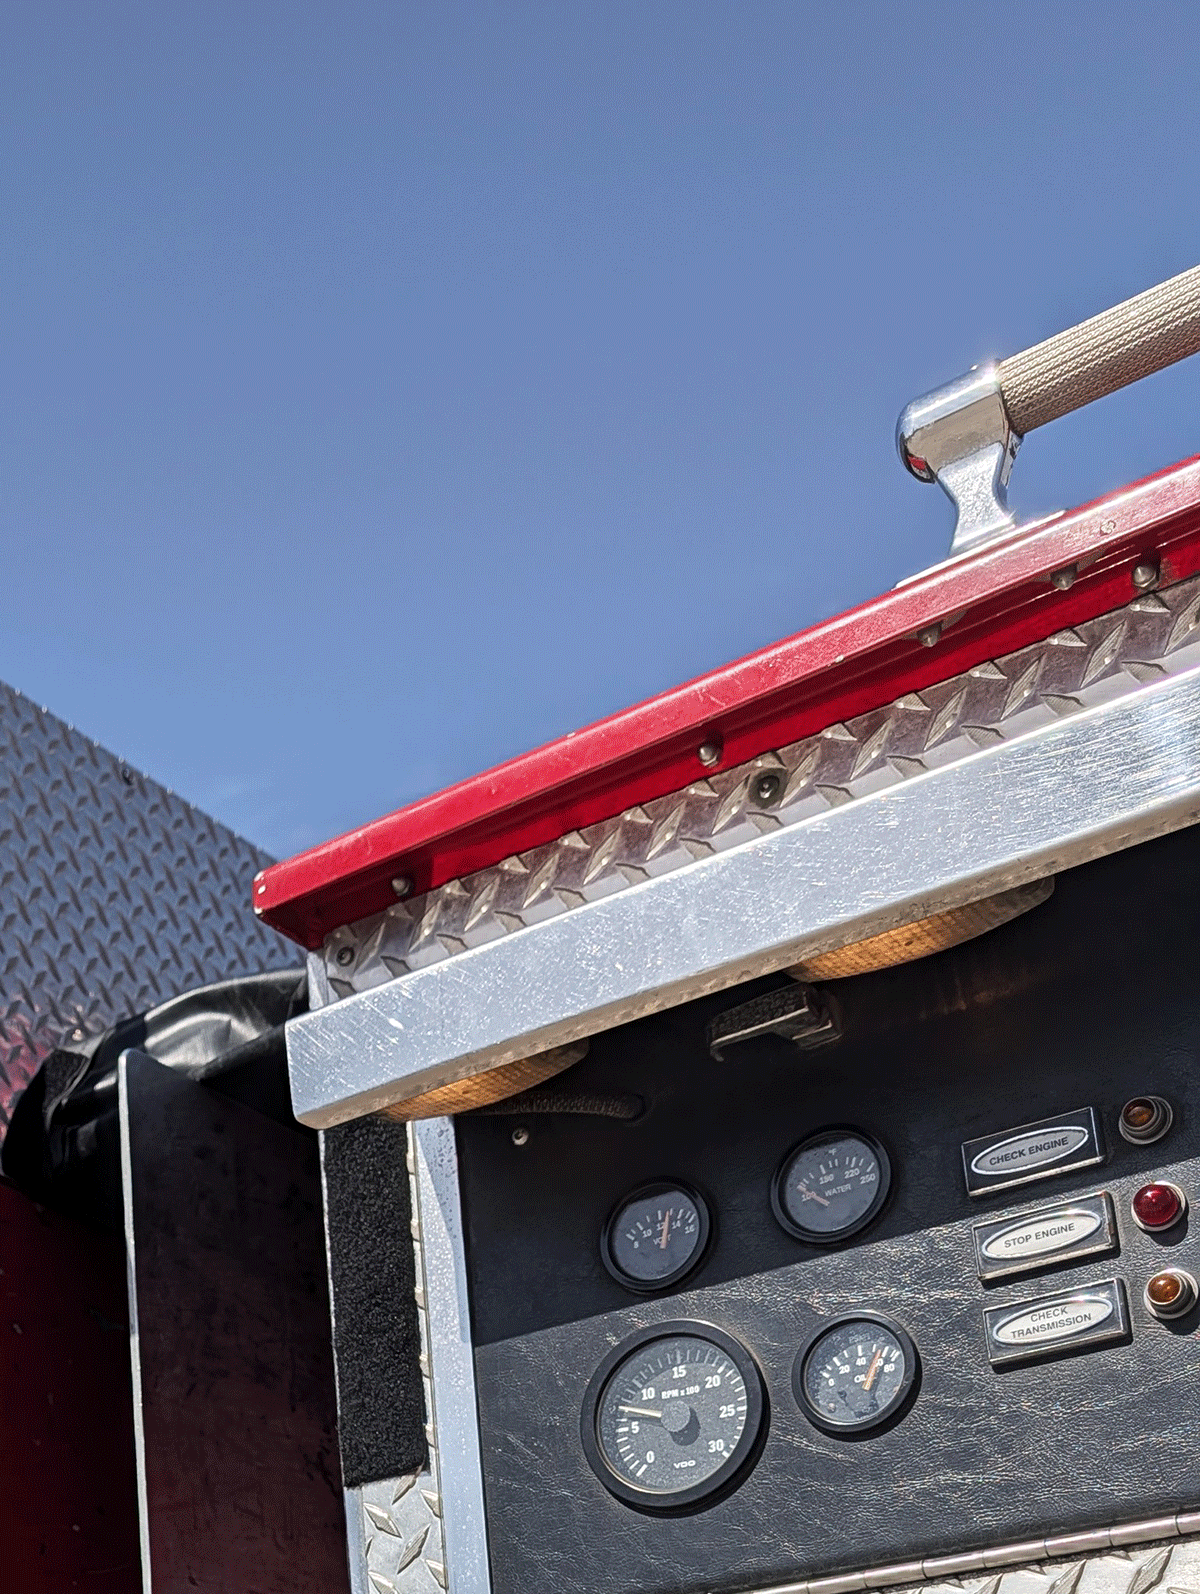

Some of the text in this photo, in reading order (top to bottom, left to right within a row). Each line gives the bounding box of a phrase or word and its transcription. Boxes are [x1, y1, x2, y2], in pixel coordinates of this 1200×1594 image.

[989, 1136, 1069, 1166] CHECK ENGINE
[844, 1168, 860, 1179] 220
[860, 1173, 876, 1185] 250
[825, 1183, 852, 1197] WATER
[672, 1221, 681, 1229] 14
[642, 1228, 652, 1238] 10
[1004, 1222, 1075, 1249] STOP ENGINE
[633, 1241, 639, 1249] 8
[1030, 1306, 1068, 1323] CHECK
[1010, 1313, 1092, 1339] TRANSMISSION
[855, 1357, 866, 1366] 40
[883, 1363, 895, 1373] 80
[672, 1365, 687, 1379] 15
[839, 1365, 850, 1374] 20
[704, 1374, 721, 1389] 20
[828, 1378, 835, 1387] 0
[641, 1387, 656, 1401] 10
[661, 1388, 679, 1399] RPM
[686, 1385, 700, 1397] 100
[719, 1404, 736, 1418] 25
[631, 1421, 640, 1434] 5
[708, 1439, 724, 1452] 30
[646, 1450, 655, 1463] 0
[673, 1460, 696, 1469] VDO
